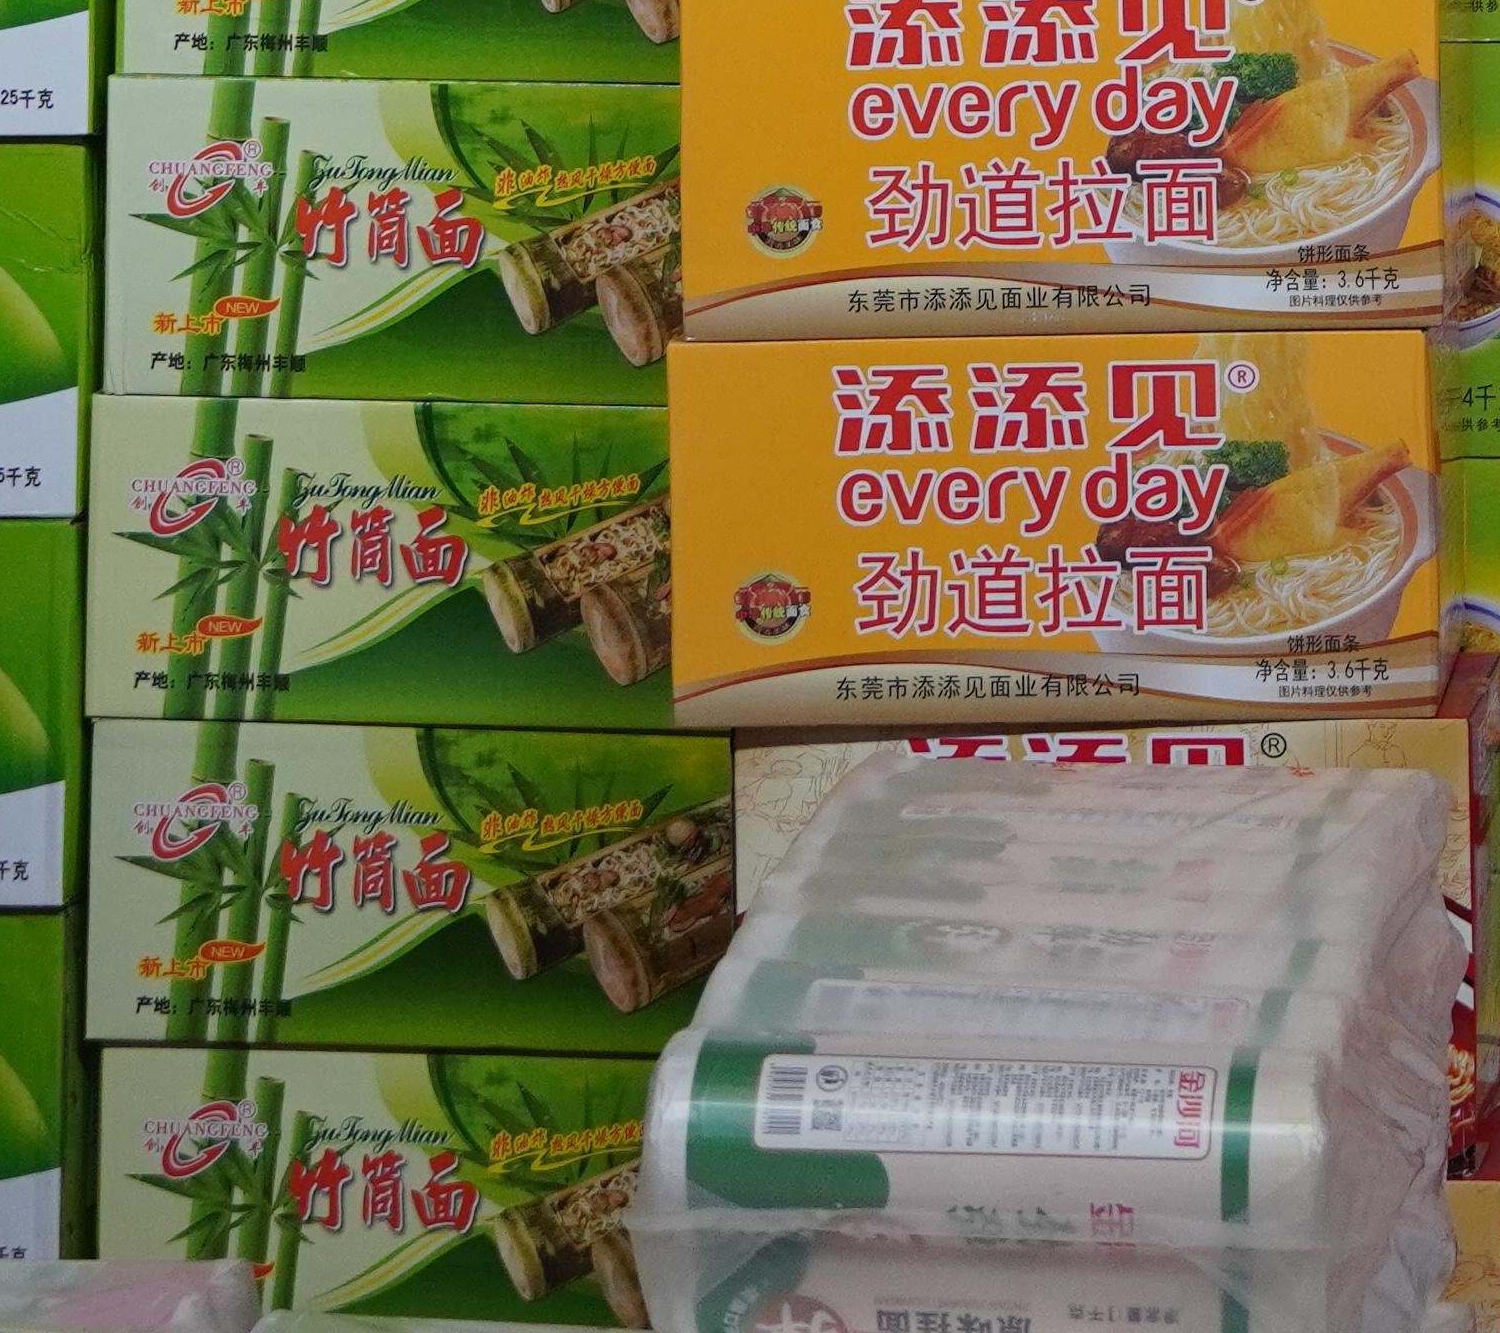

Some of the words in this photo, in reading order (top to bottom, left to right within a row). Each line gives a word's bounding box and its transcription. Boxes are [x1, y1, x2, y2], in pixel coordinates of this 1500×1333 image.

[847, 80, 1075, 149] every
[1095, 67, 1237, 149] day
[295, 189, 484, 269] 竹筒面
[865, 160, 1219, 248] 劲道拉面
[1297, 244, 1370, 263] 饼形面条
[847, 284, 1152, 312] 东莞市添添见面业有限公司
[832, 360, 1224, 456] 添添见
[838, 466, 1066, 535] every
[1084, 455, 1227, 535] day
[853, 548, 1209, 637] 劲道拉面
[290, 1149, 480, 1232] 竹筒面
